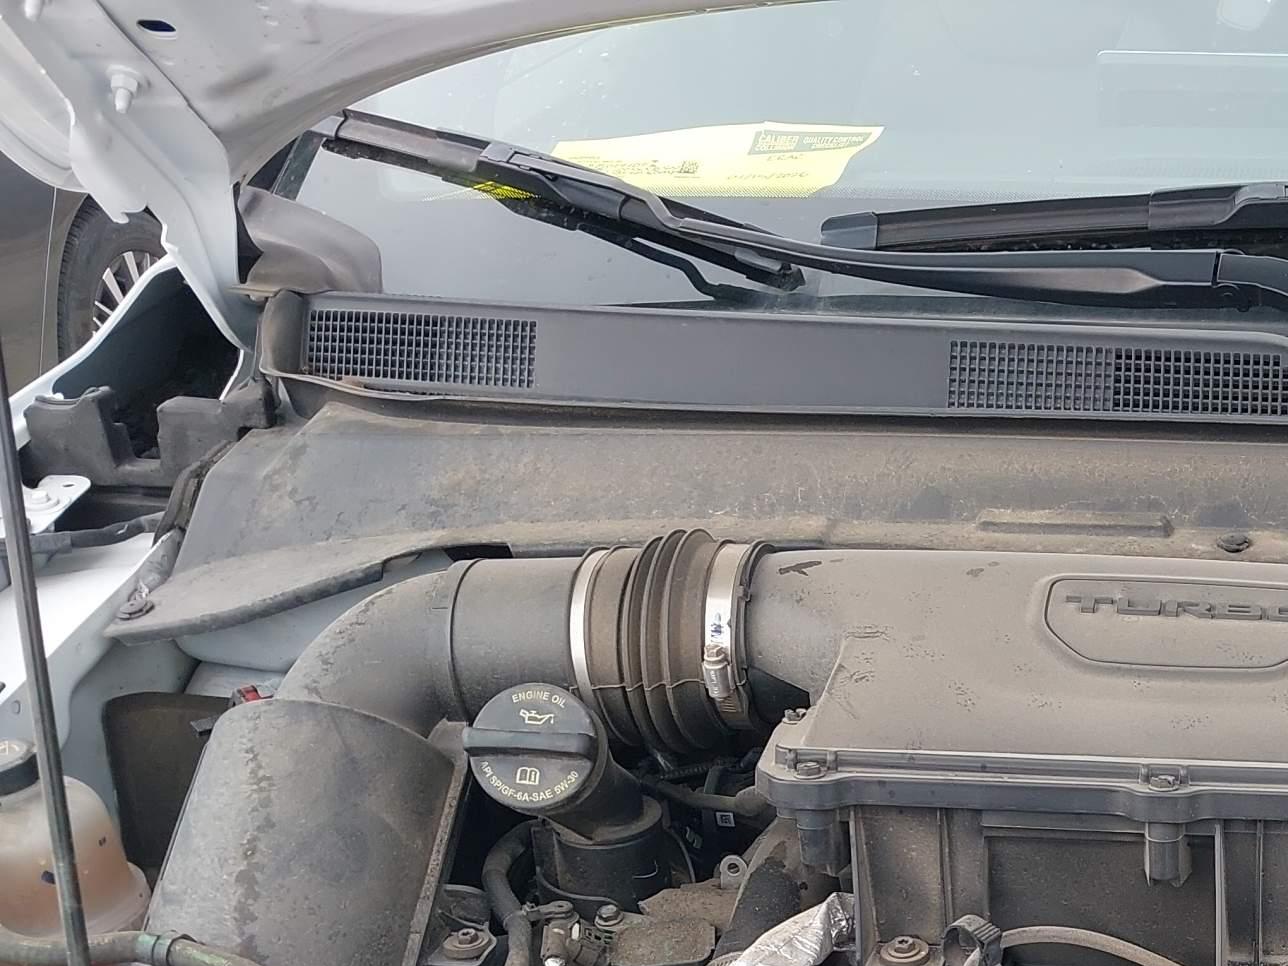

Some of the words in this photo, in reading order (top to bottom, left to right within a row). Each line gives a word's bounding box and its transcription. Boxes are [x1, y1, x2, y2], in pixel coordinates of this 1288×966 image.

[512, 690, 550, 703] ENGINE
[551, 694, 566, 709] OIL
[481, 761, 491, 778] API
[554, 770, 580, 795] 5W-30
